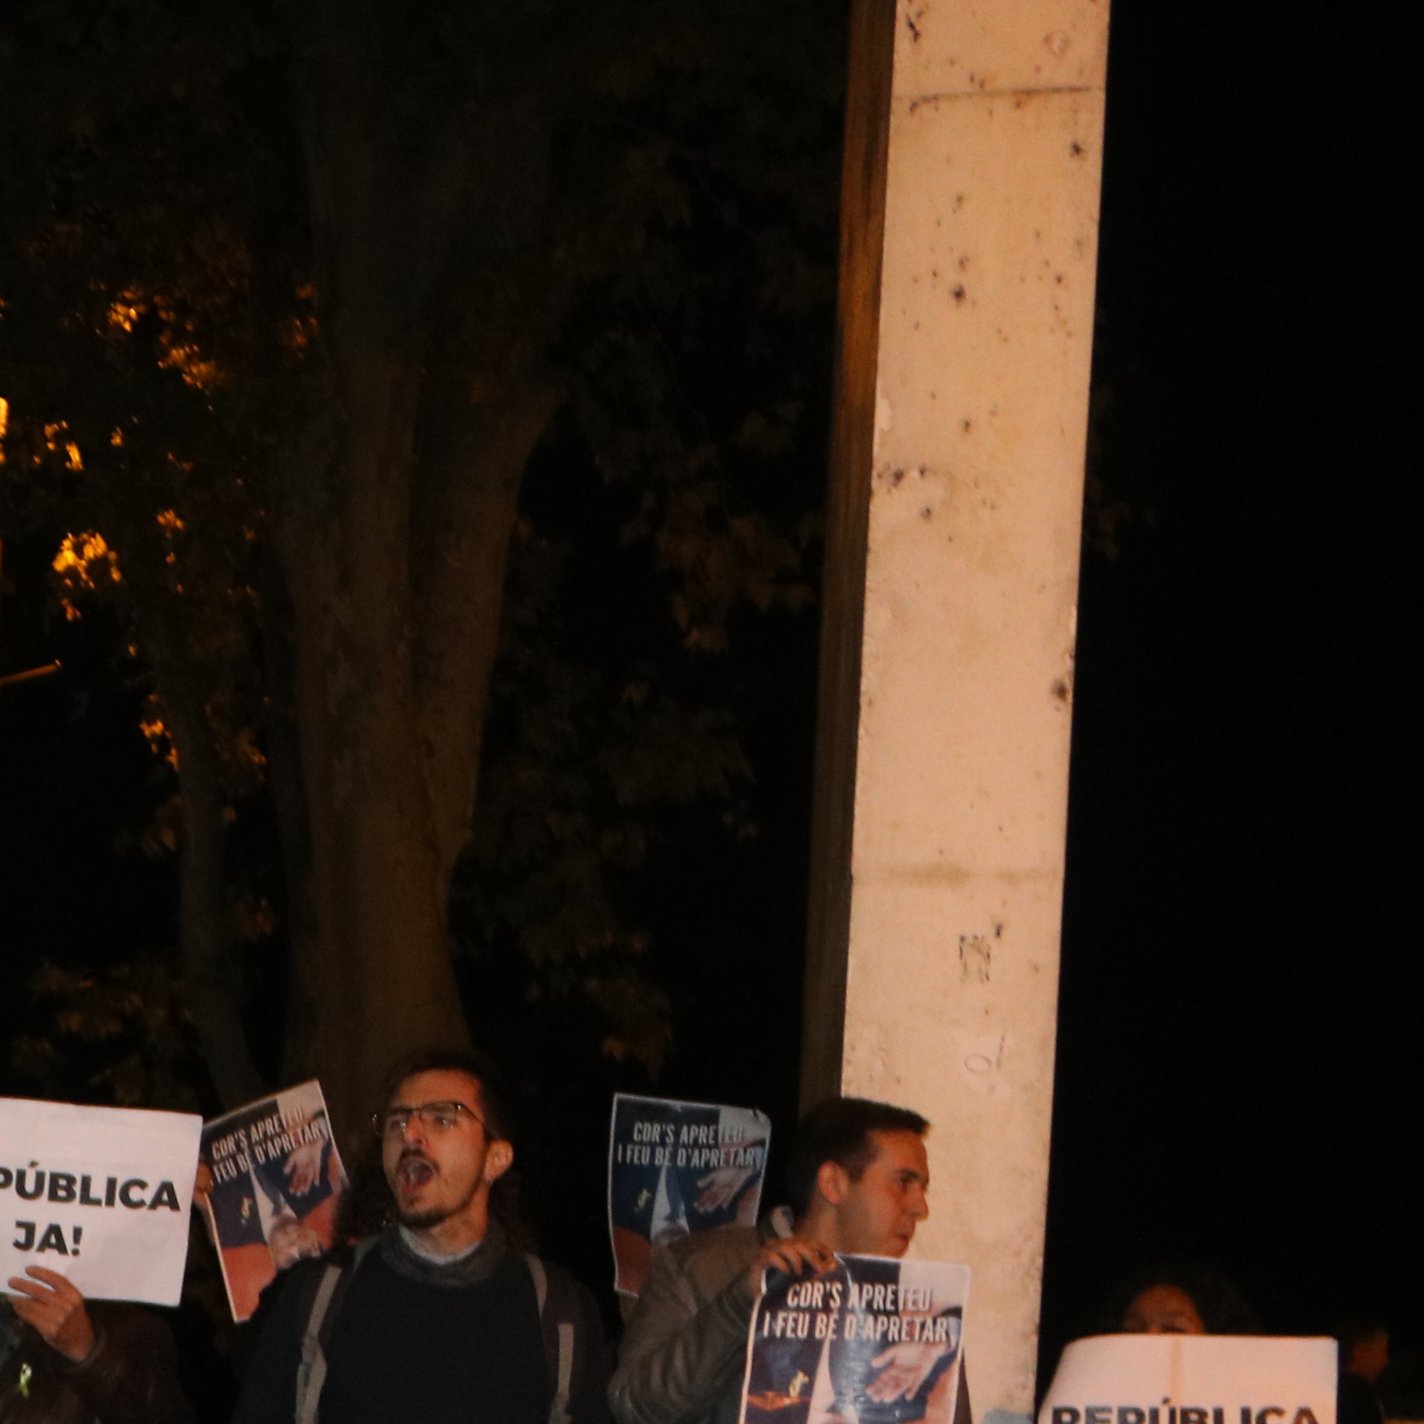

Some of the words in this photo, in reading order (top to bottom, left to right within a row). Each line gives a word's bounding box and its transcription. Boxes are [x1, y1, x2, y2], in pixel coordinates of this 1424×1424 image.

[632, 1120, 675, 1143] CDR'S
[679, 1124, 743, 1145] APRETEU
[617, 1143, 623, 1164] I
[626, 1144, 651, 1165] FEU
[654, 1143, 671, 1167] BÉ
[676, 1147, 756, 1169] D'APRETAR
[12, 1220, 83, 1258] JA!
[787, 1281, 843, 1310] CDR'S
[847, 1283, 933, 1312] APRETEU
[763, 1311, 770, 1338] I
[776, 1311, 810, 1339] FEU
[814, 1309, 840, 1340] BÉ
[844, 1314, 950, 1343] D'APRETAR
